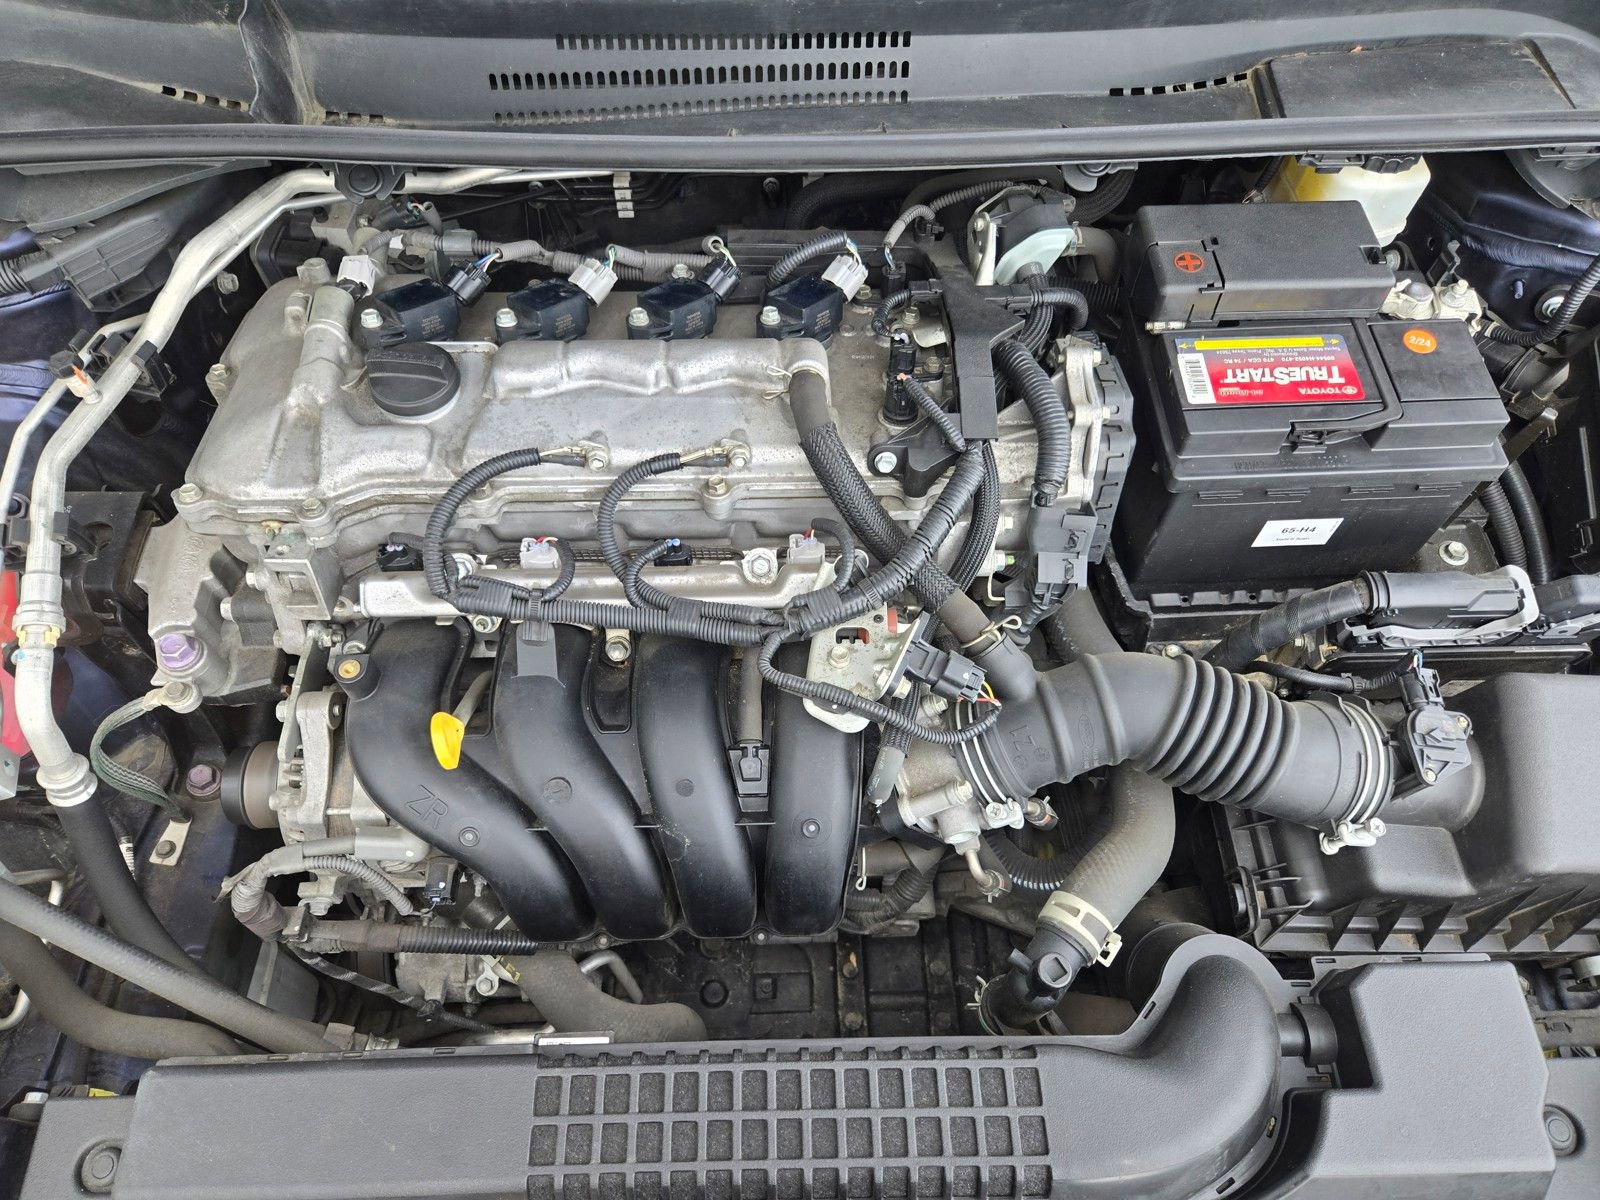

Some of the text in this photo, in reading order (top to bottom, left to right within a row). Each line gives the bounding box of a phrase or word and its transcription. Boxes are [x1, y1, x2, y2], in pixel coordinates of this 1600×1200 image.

[1409, 335, 1431, 348] 2/24
[1298, 387, 1341, 395] TOYOTA
[1281, 526, 1317, 534] 65-H4
[404, 783, 449, 830] ZR
